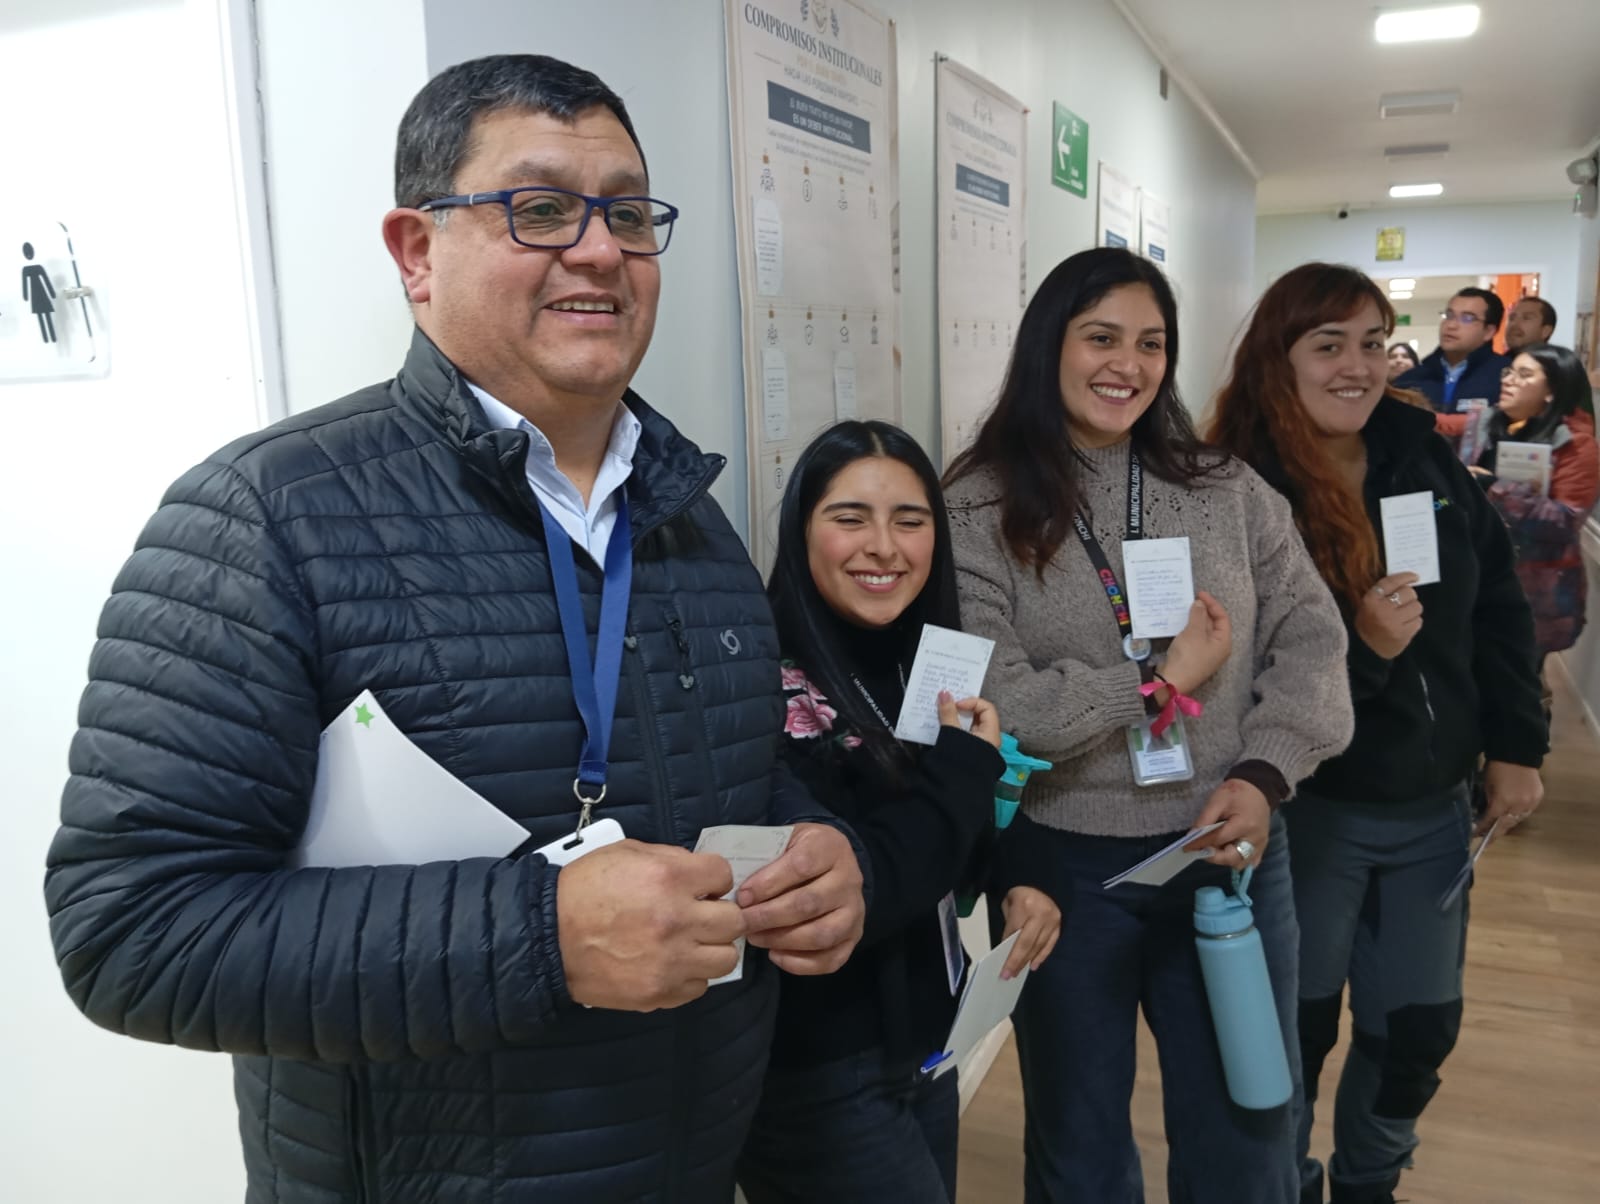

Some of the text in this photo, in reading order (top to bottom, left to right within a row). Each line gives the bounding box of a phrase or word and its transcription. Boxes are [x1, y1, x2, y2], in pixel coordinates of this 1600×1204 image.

[744, 3, 817, 56] COMPROMISOS
[818, 40, 882, 87] INSTITUCIONALES
[1130, 464, 1140, 527] MUNICIPALIDAD
[1099, 568, 1130, 626] CHONCHI
